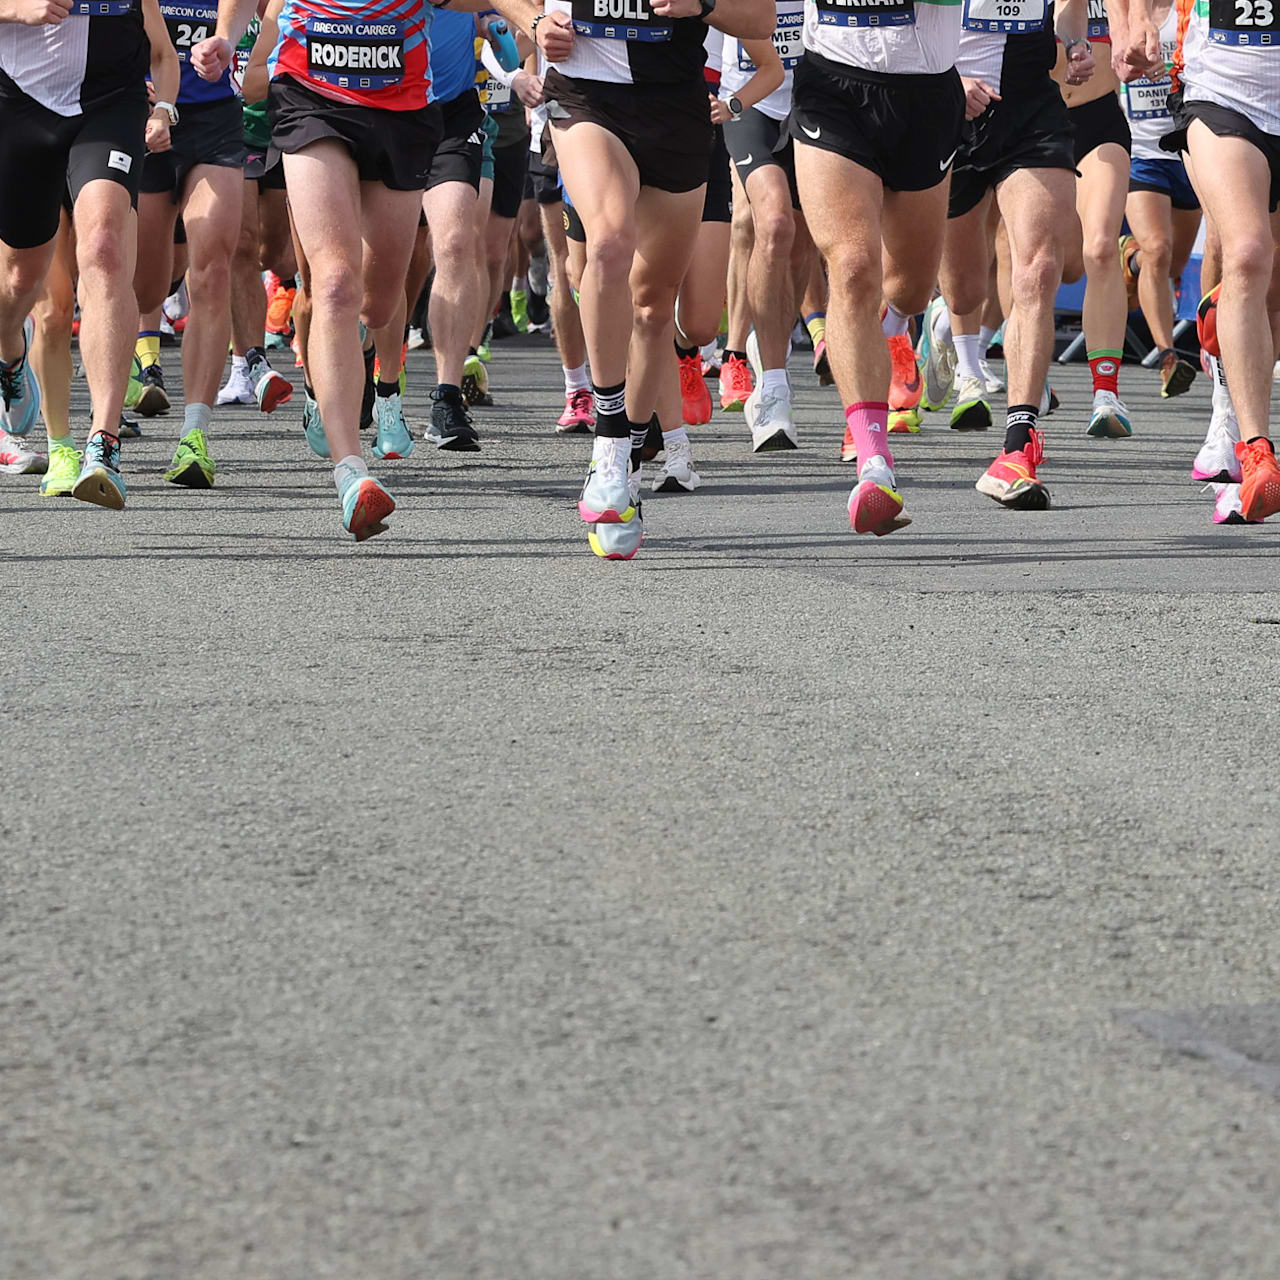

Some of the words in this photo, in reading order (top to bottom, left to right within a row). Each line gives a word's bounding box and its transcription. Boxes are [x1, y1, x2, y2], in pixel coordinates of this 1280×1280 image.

[160, 5, 194, 17] BRECON
[996, 5, 1021, 17] 109
[776, 15, 804, 25] CARRE
[313, 21, 354, 35] BRECON
[355, 24, 397, 36] CARREG
[176, 23, 208, 47] 24
[311, 41, 402, 69] RODERICK
[775, 45, 789, 55] 10
[1138, 88, 1170, 98] DANIE
